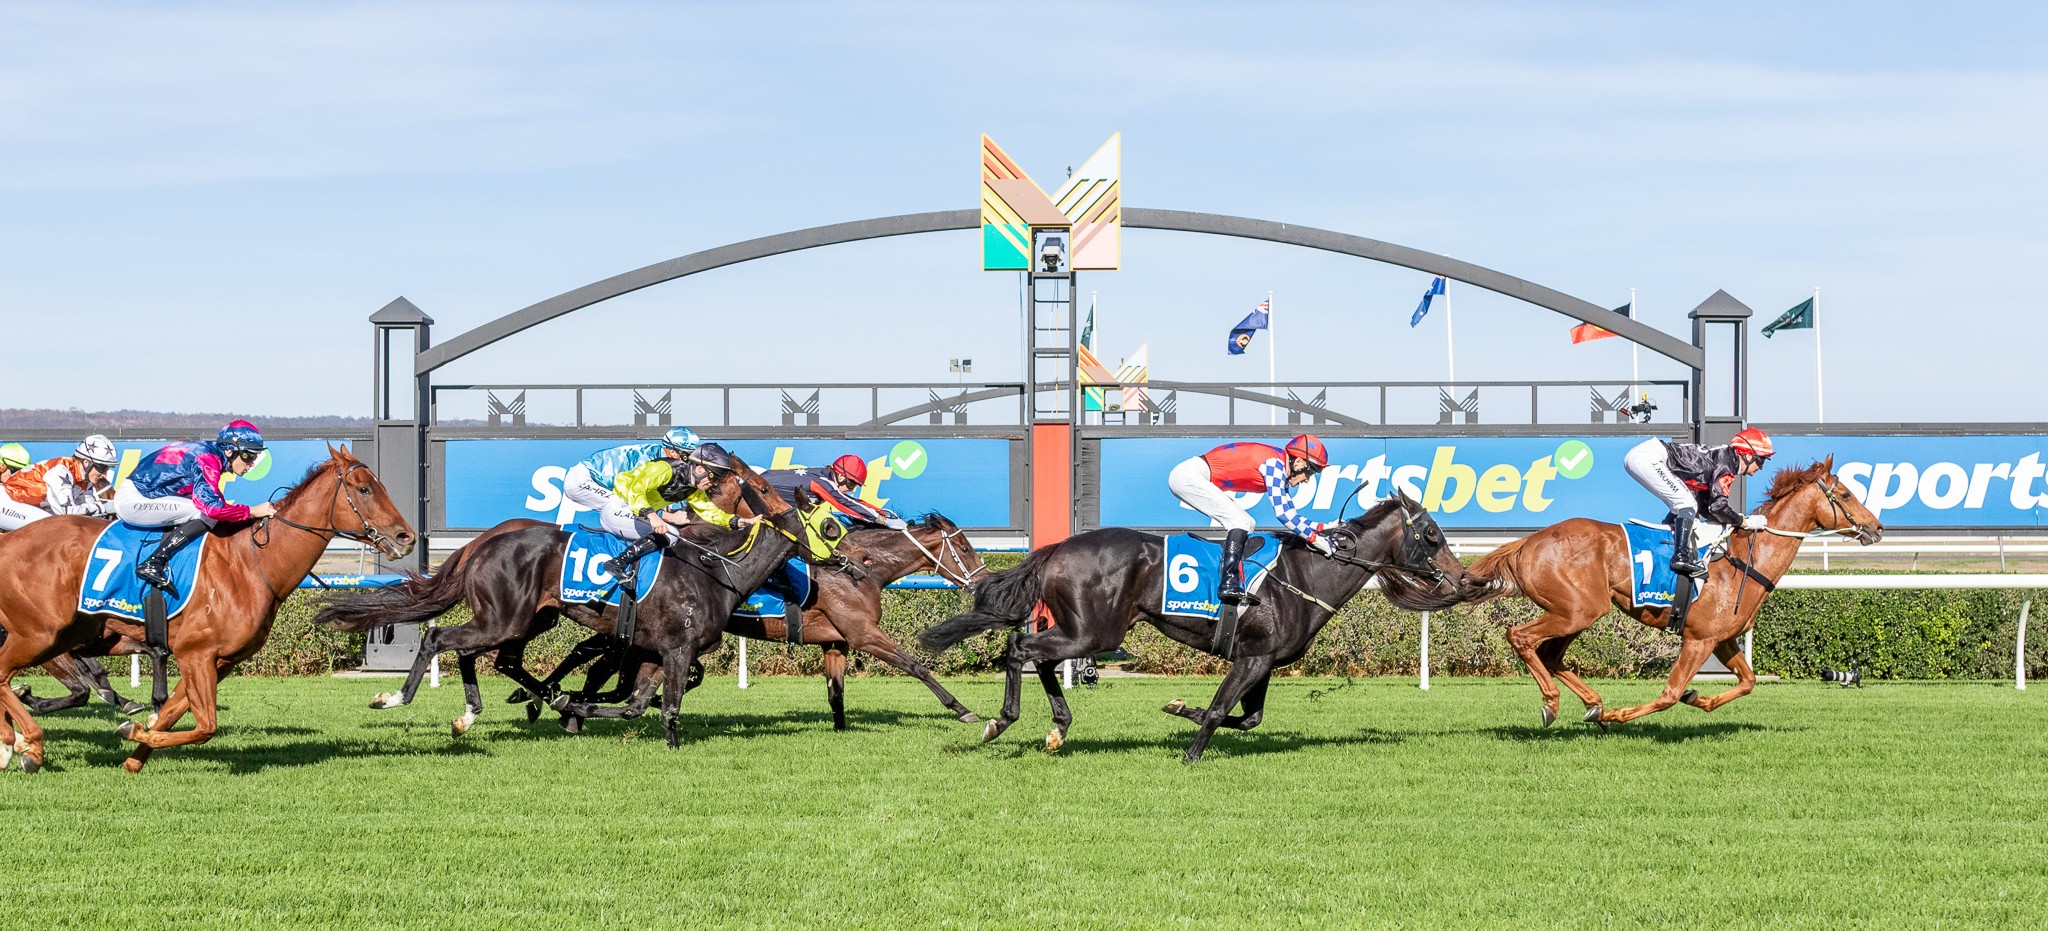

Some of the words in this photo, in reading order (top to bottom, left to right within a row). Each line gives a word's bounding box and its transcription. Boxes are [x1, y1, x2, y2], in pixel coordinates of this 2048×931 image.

[1836, 451, 2048, 520] sport
[92, 548, 123, 592] 7
[569, 547, 613, 585] 10
[1169, 554, 1199, 593] 6
[1634, 550, 1654, 585] 1
[84, 597, 138, 614] sportsbet
